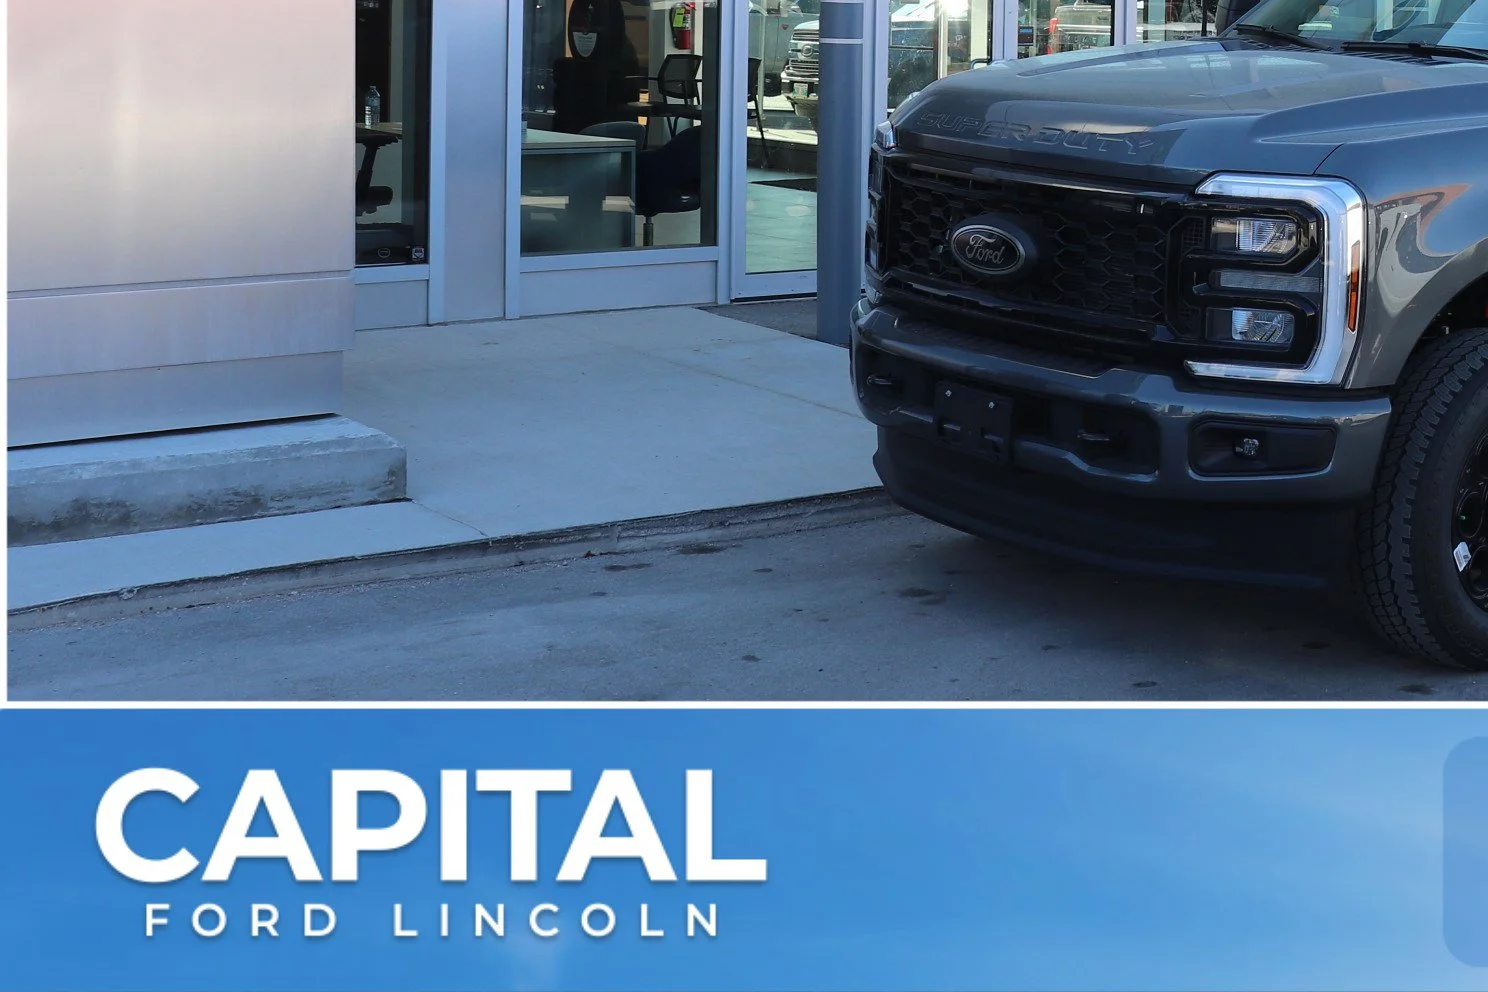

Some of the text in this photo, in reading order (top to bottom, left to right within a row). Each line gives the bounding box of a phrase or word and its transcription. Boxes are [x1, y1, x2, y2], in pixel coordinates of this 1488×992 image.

[917, 112, 1154, 155] SUPER DUTY
[965, 234, 1005, 265] Ford
